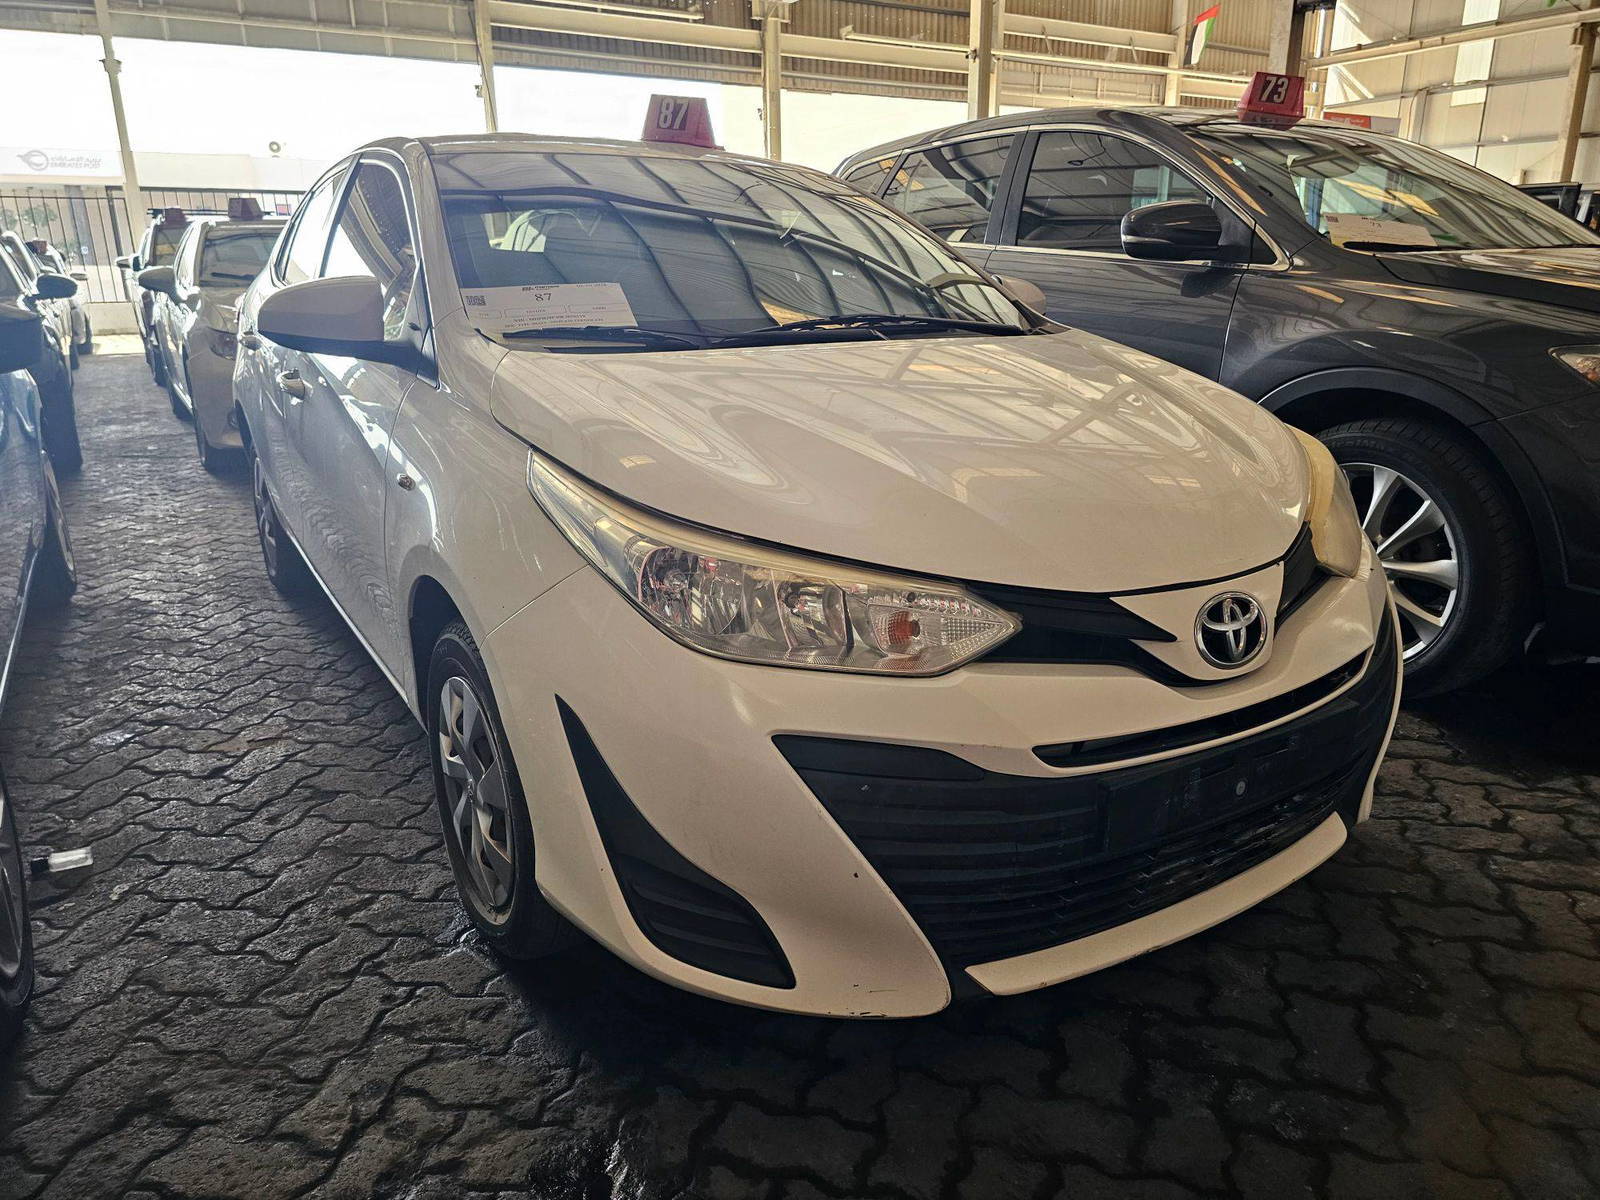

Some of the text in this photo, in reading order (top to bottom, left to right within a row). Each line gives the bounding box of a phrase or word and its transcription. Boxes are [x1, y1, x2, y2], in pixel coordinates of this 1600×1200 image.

[1260, 76, 1289, 103] 73
[658, 97, 689, 129] 87
[534, 292, 552, 302] 87
